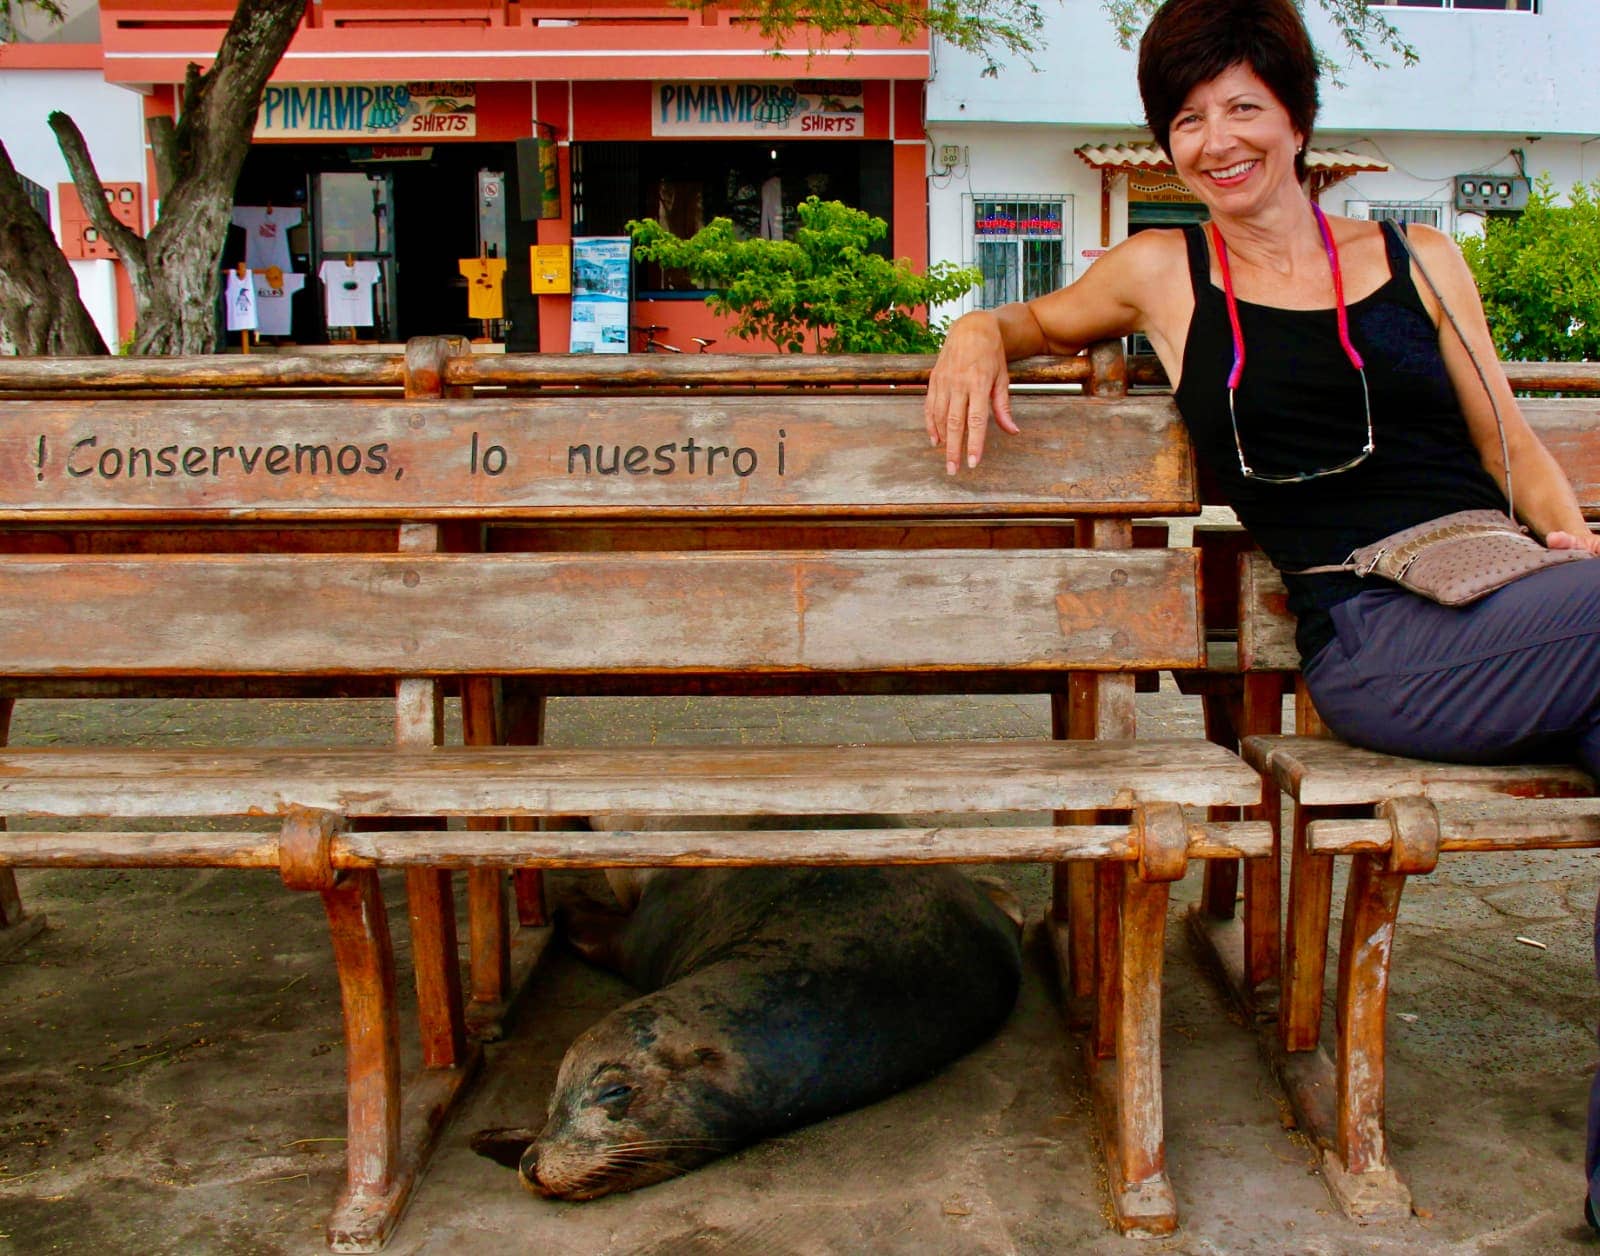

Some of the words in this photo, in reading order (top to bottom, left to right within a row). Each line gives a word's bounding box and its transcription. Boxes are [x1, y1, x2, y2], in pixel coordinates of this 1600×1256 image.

[264, 84, 411, 132] PIMAMPIRO
[412, 113, 468, 133] SHIRTS
[660, 84, 798, 124] PIMAMPIRO
[801, 114, 857, 132] SHIRTS
[66, 435, 404, 481] Conservemos,
[470, 431, 508, 477] lo
[567, 437, 758, 478] nuestro
